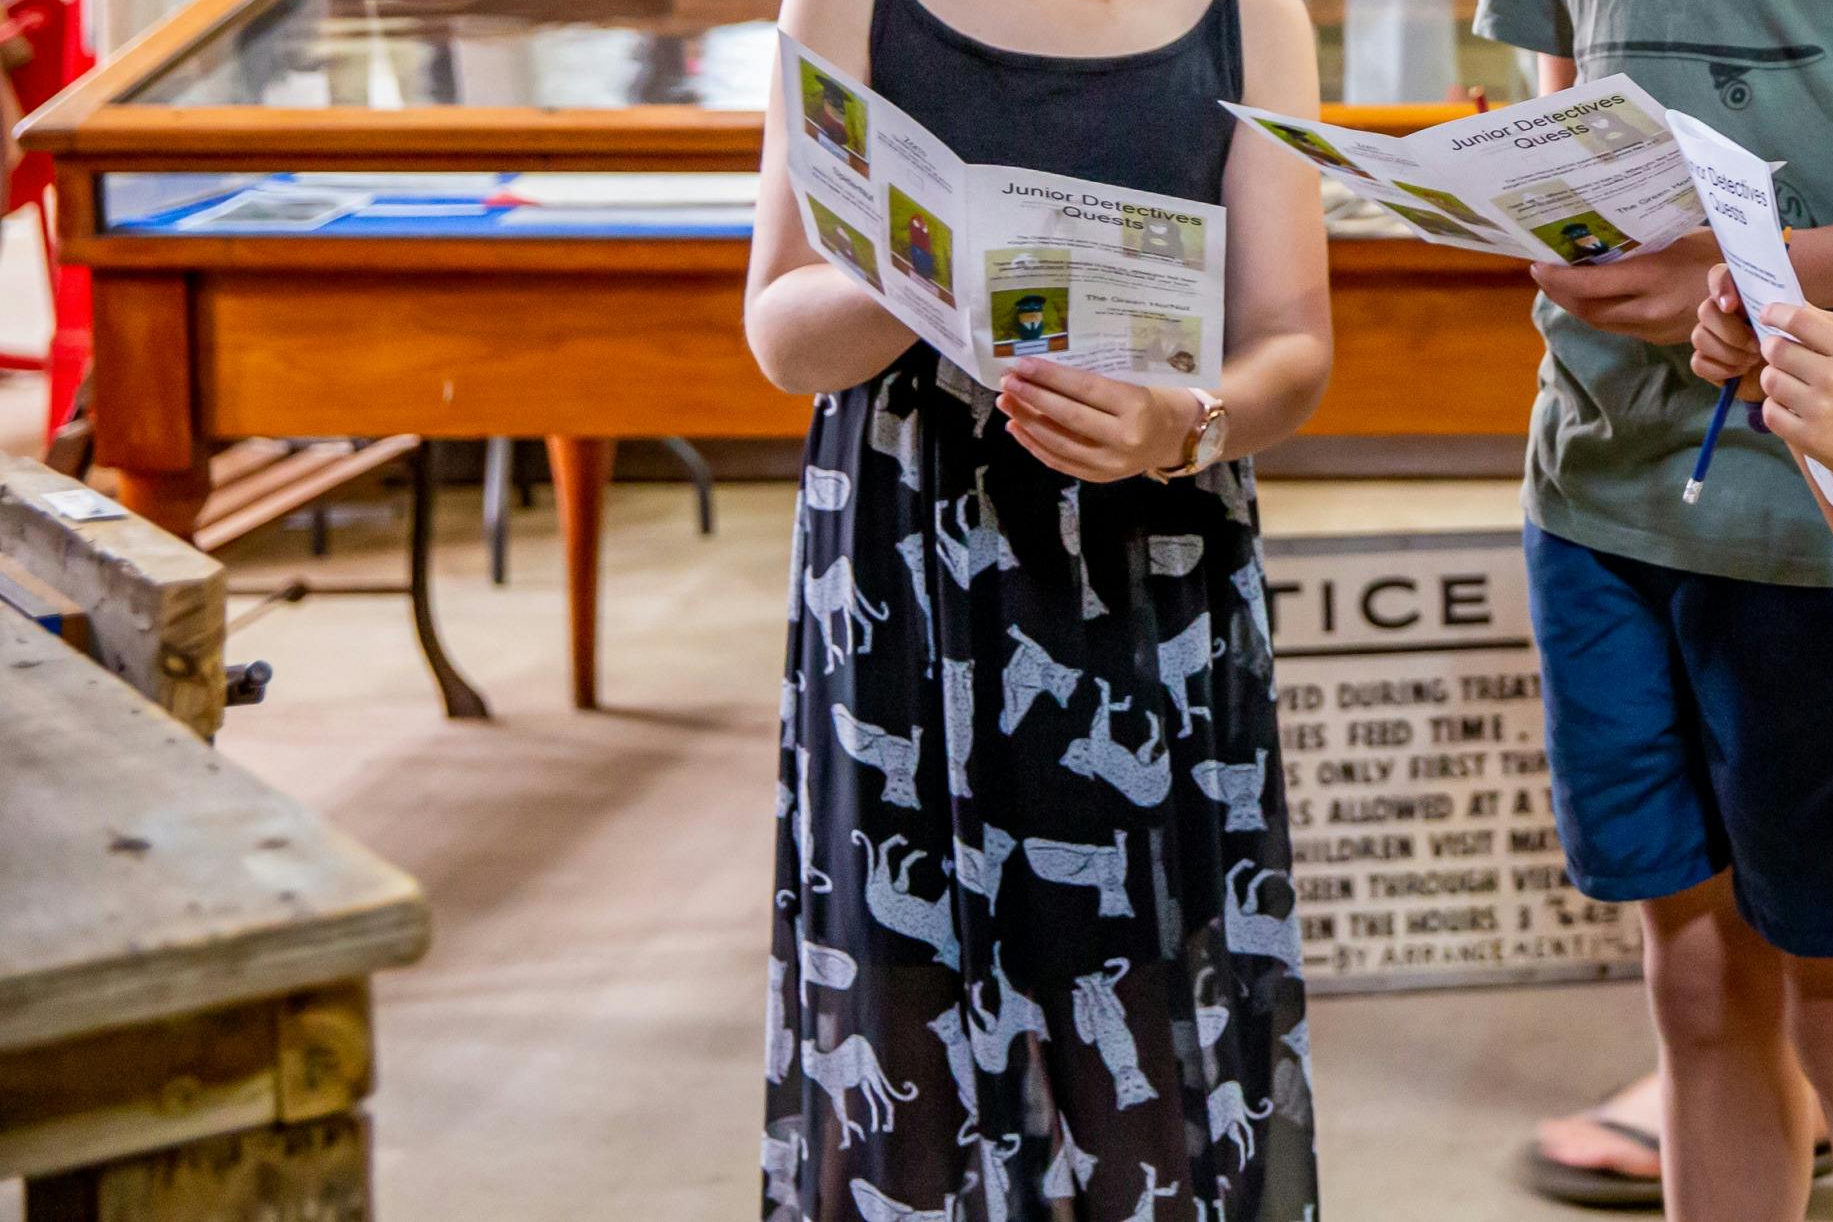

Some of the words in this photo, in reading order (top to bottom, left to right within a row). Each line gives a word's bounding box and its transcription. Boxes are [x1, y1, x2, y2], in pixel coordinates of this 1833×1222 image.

[1450, 125, 1511, 151] Junior
[1513, 94, 1626, 132] Detectives
[1514, 123, 1590, 150] Quests
[1002, 182, 1075, 202] Junior
[1083, 194, 1202, 226] Detectives
[1707, 166, 1767, 208] Detectives
[1063, 206, 1144, 230] Quests
[1709, 191, 1748, 225] Quests
[1337, 677, 1449, 710] DURING
[1347, 718, 1414, 748] FEED
[1316, 754, 1395, 786] ONLY
[1408, 752, 1486, 780] FIRST
[1328, 791, 1453, 824] ALLOWED
[1466, 788, 1500, 818] AT
[1511, 788, 1532, 814] A
[1428, 829, 1494, 858] VISIT
[1368, 866, 1500, 897] THROUGH
[1350, 909, 1395, 938] THE
[1406, 902, 1498, 934] HOURS
